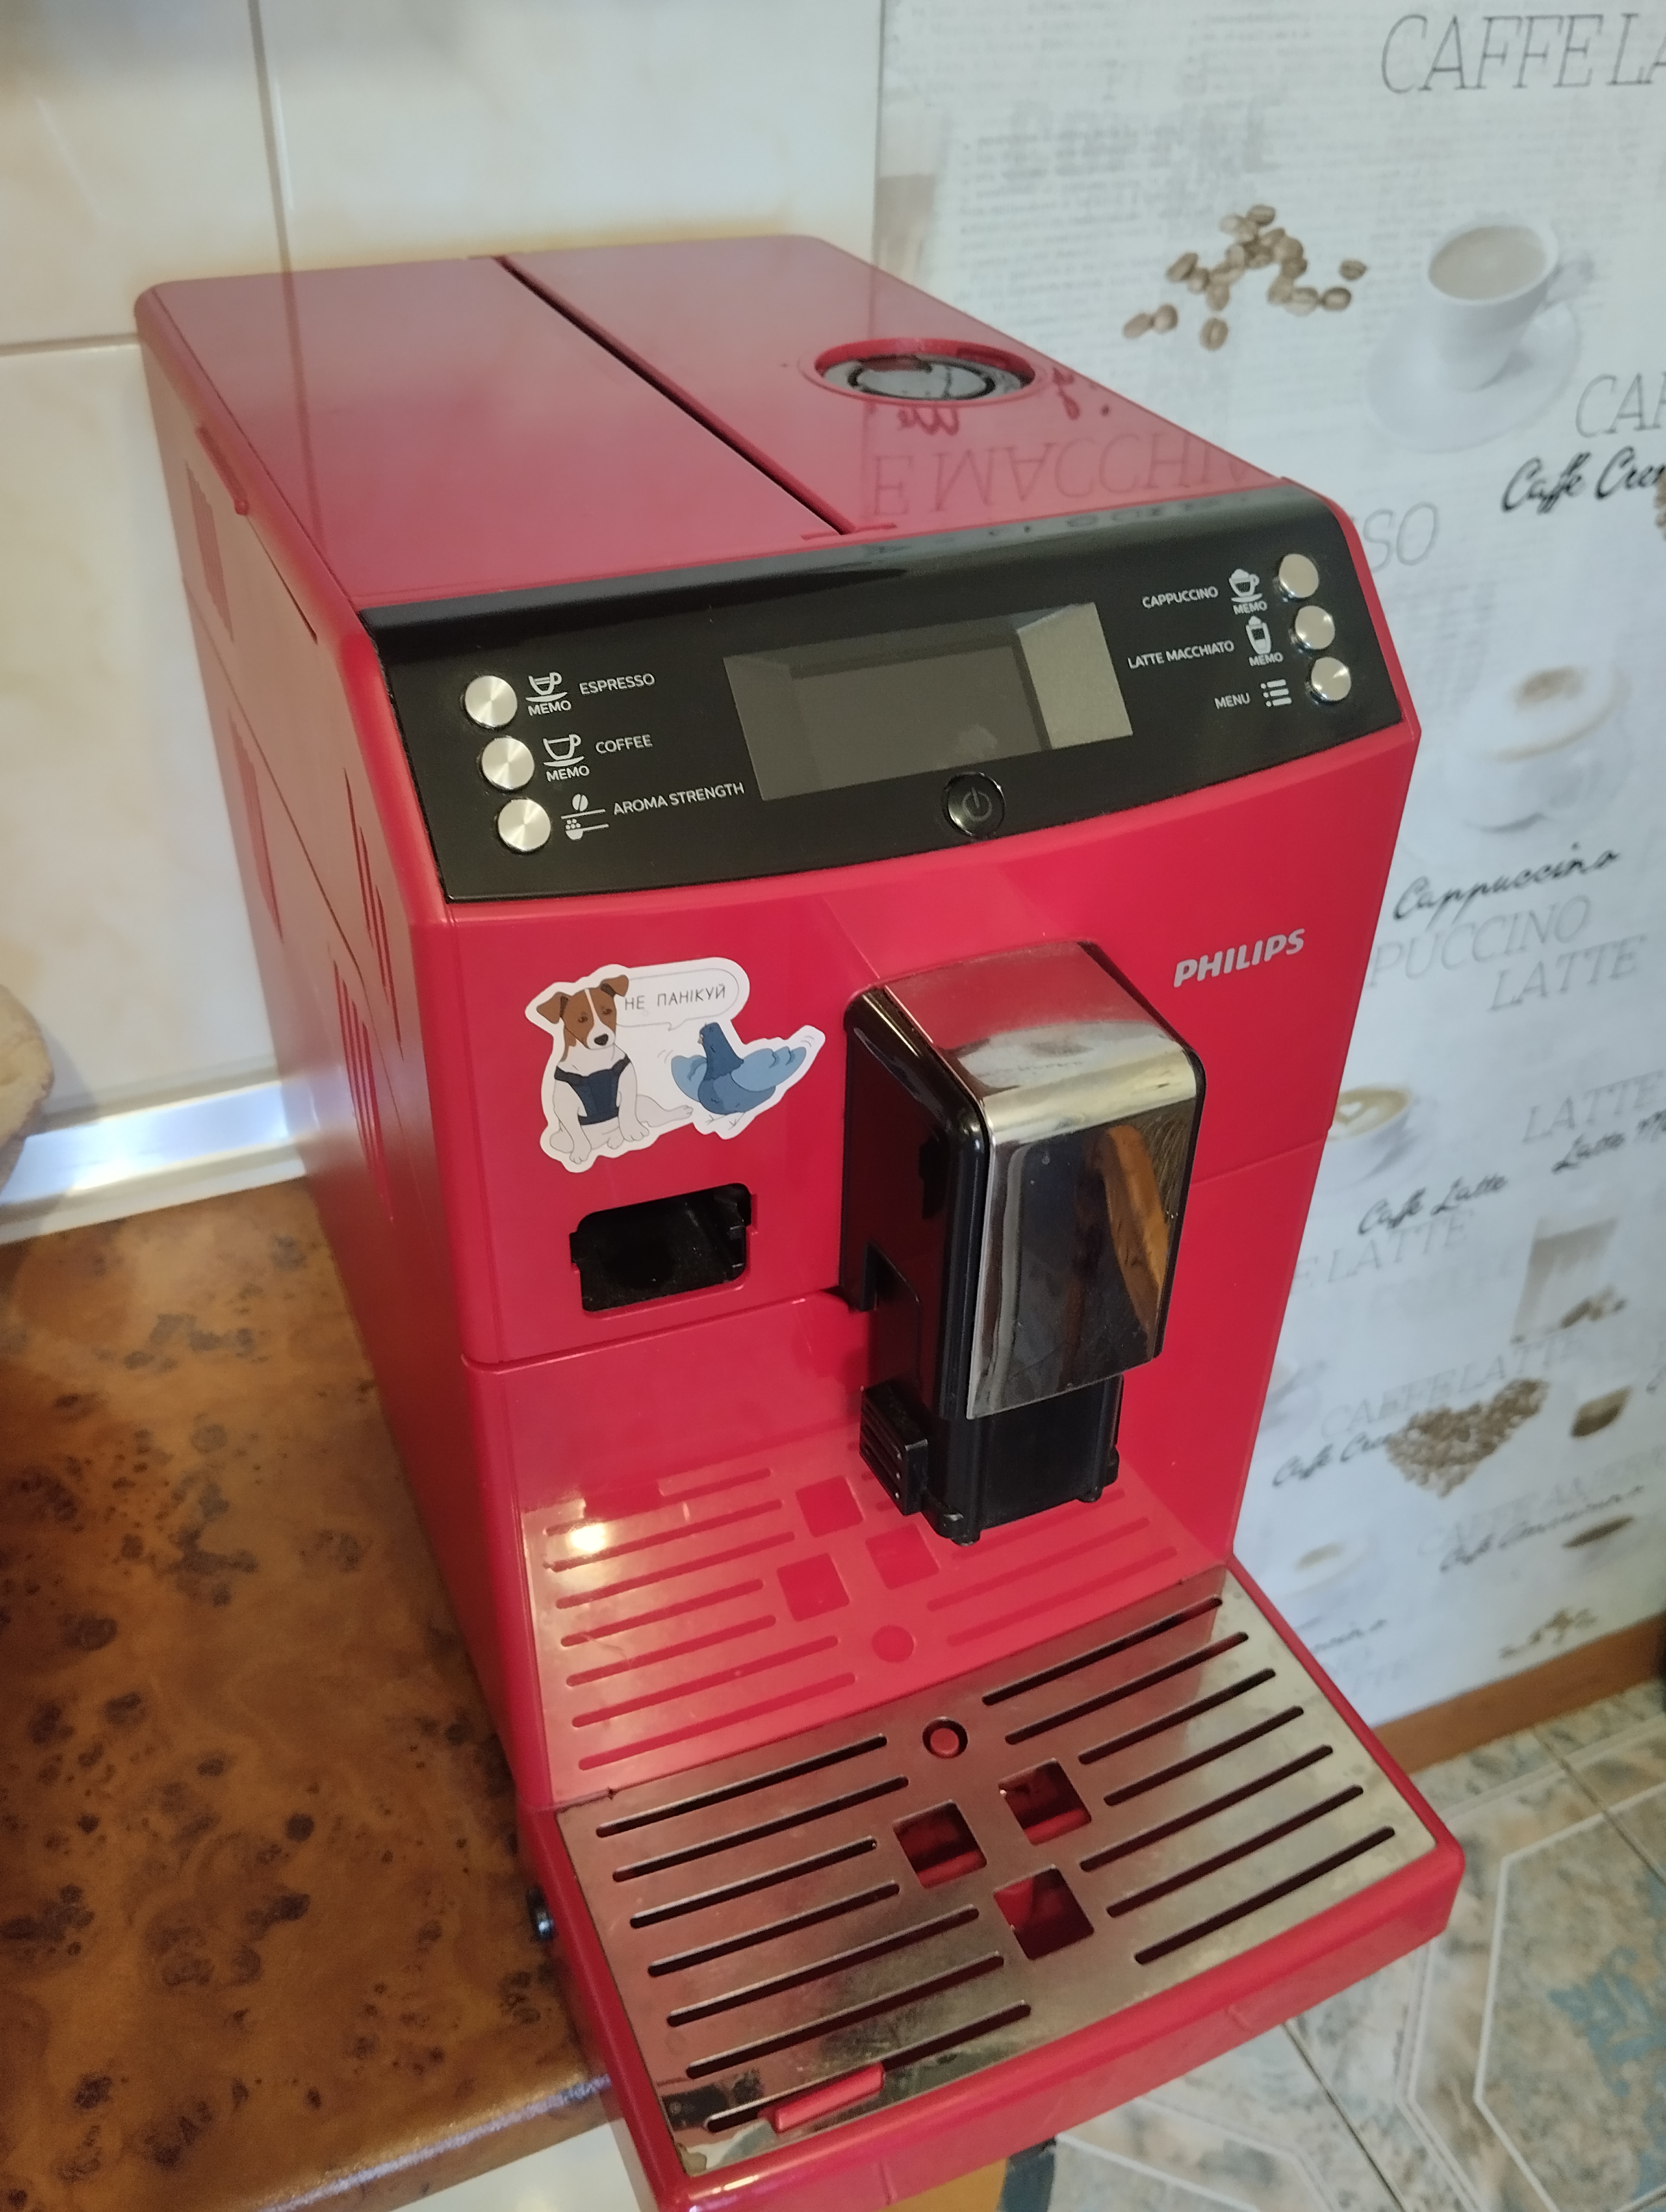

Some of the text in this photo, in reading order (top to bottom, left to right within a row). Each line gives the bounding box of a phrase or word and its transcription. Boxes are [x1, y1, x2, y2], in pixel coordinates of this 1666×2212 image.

[1142, 586, 1219, 609] CAPPUCCINO
[1233, 601, 1267, 615] MEMO
[1127, 640, 1235, 670] LATTE MACCHIATO
[1249, 652, 1284, 667] MEMO
[579, 673, 655, 695] ESPRESSO
[528, 700, 572, 716] MEMO
[1214, 693, 1250, 709] MENU
[595, 734, 653, 754] COFFEE
[546, 766, 590, 782] MEMO
[613, 781, 745, 815] AROMA STRENGTH
[1393, 842, 1621, 931] Cappuccino
[1174, 928, 1305, 988] PHILIPS
[1488, 934, 1648, 1012] LATTE
[625, 983, 725, 1011] НЕ ПАНІКУЙ
